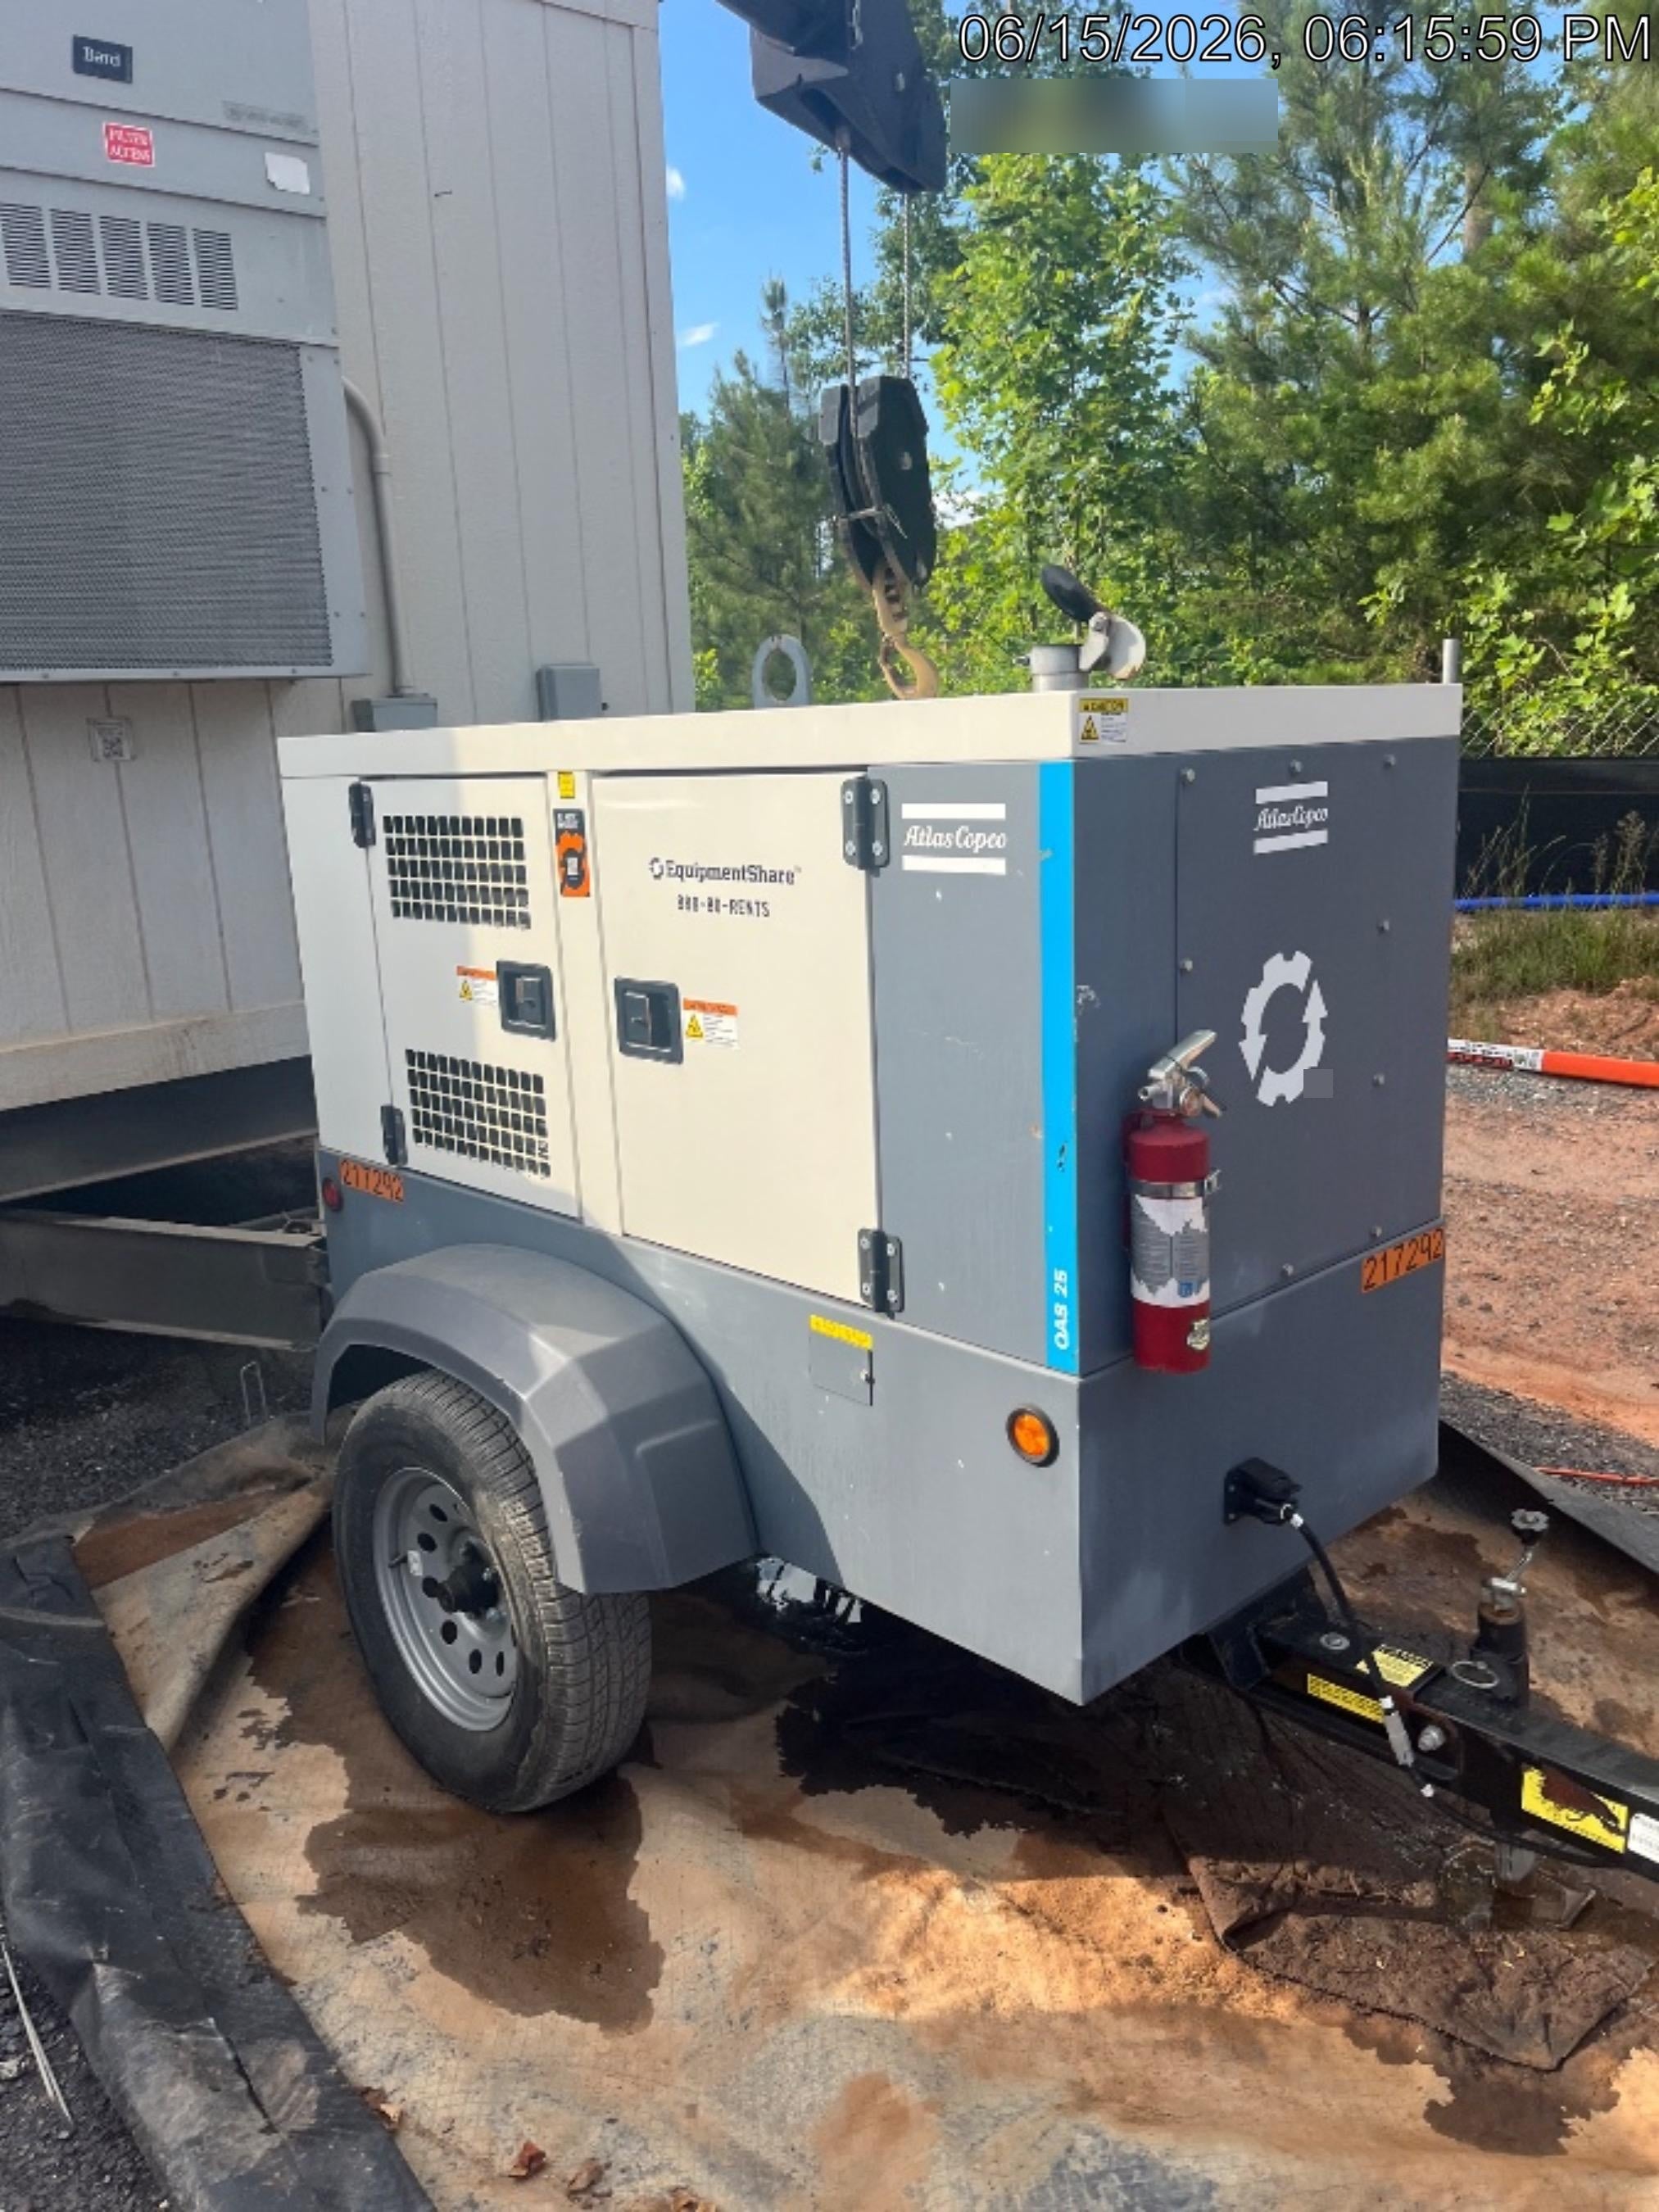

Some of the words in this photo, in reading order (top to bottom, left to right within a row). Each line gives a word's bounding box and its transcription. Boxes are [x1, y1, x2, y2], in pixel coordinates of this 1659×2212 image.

[904, 825, 954, 849] Atlas
[955, 825, 1006, 853] Copco
[664, 859, 796, 885] EquipmentShare
[1363, 1227, 1445, 1291] 217292
